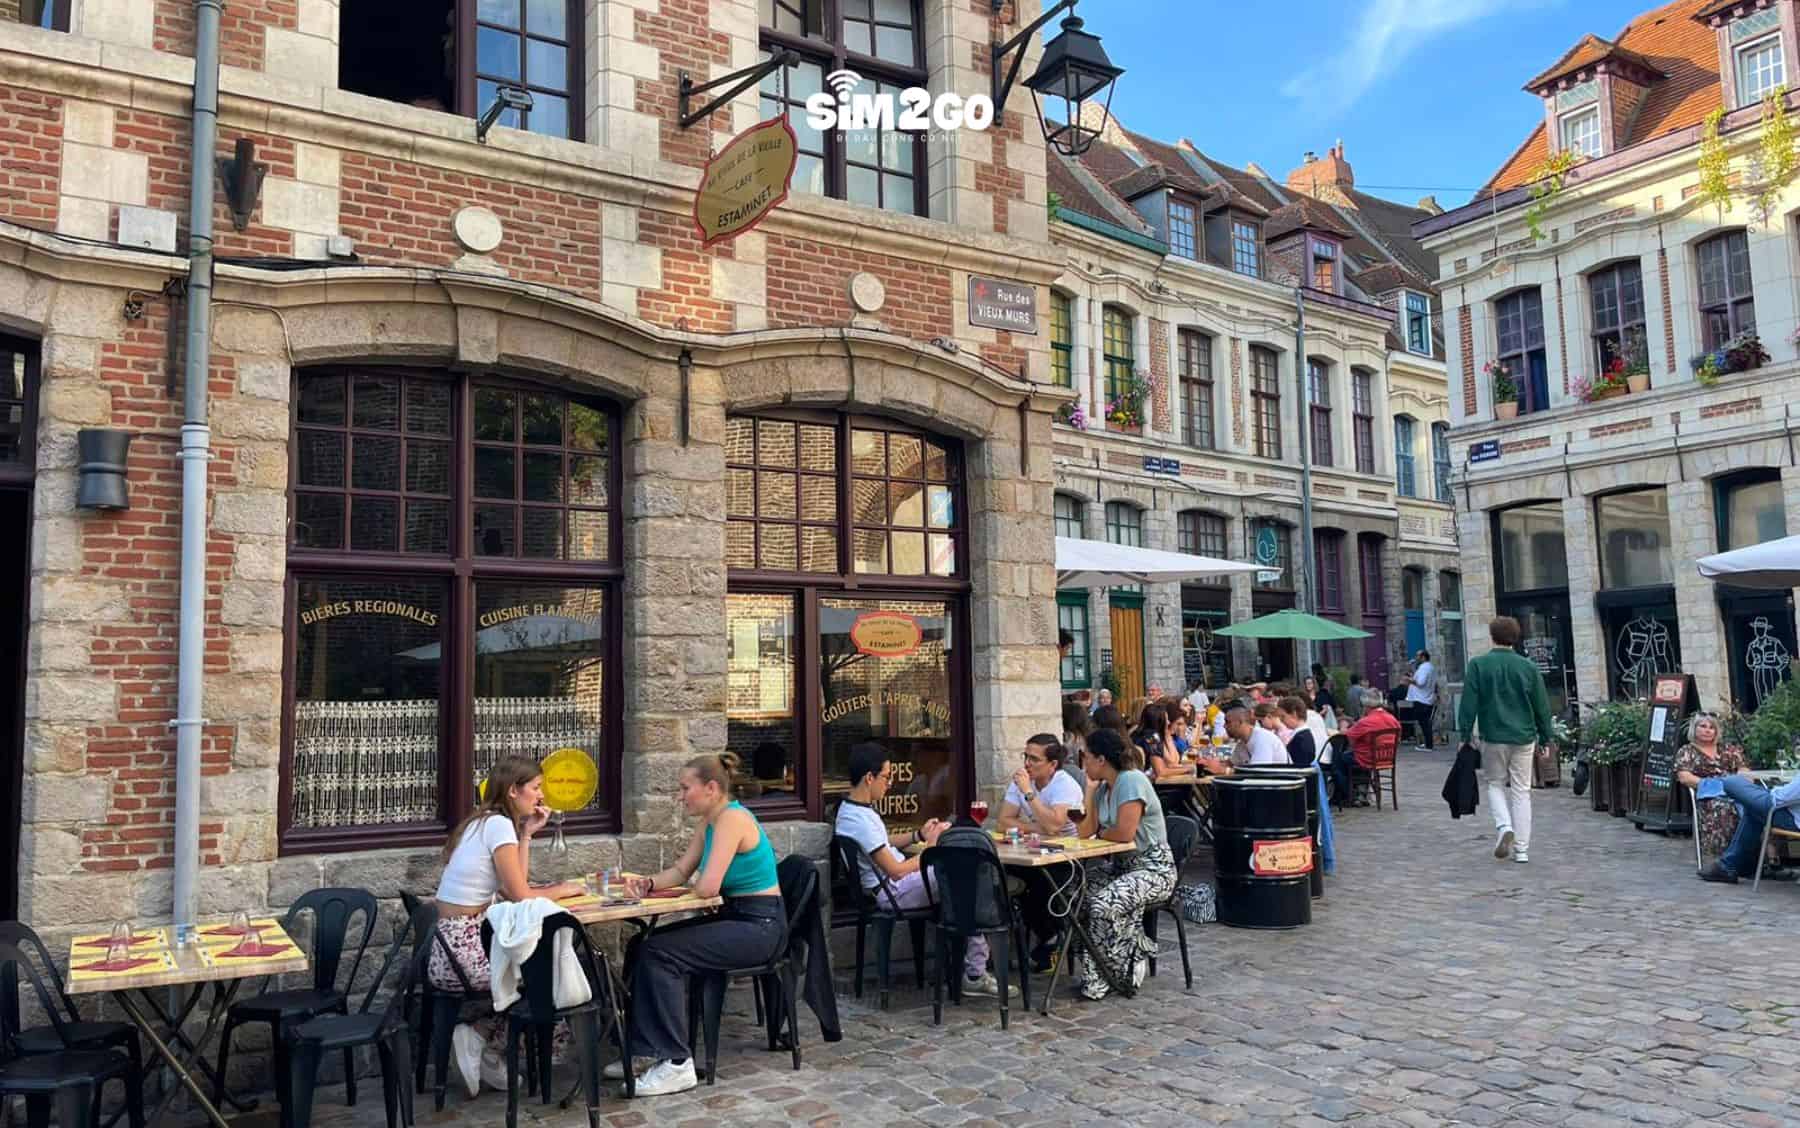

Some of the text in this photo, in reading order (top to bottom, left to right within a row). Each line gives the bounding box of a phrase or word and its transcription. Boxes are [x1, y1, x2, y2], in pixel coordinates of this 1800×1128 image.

[717, 184, 772, 228] ESTAMINET
[996, 288, 1031, 305] Rue des
[977, 303, 1031, 324] VIEUX MURS
[301, 600, 439, 627] BIERES REGIONALES
[479, 604, 530, 627] CUISINE
